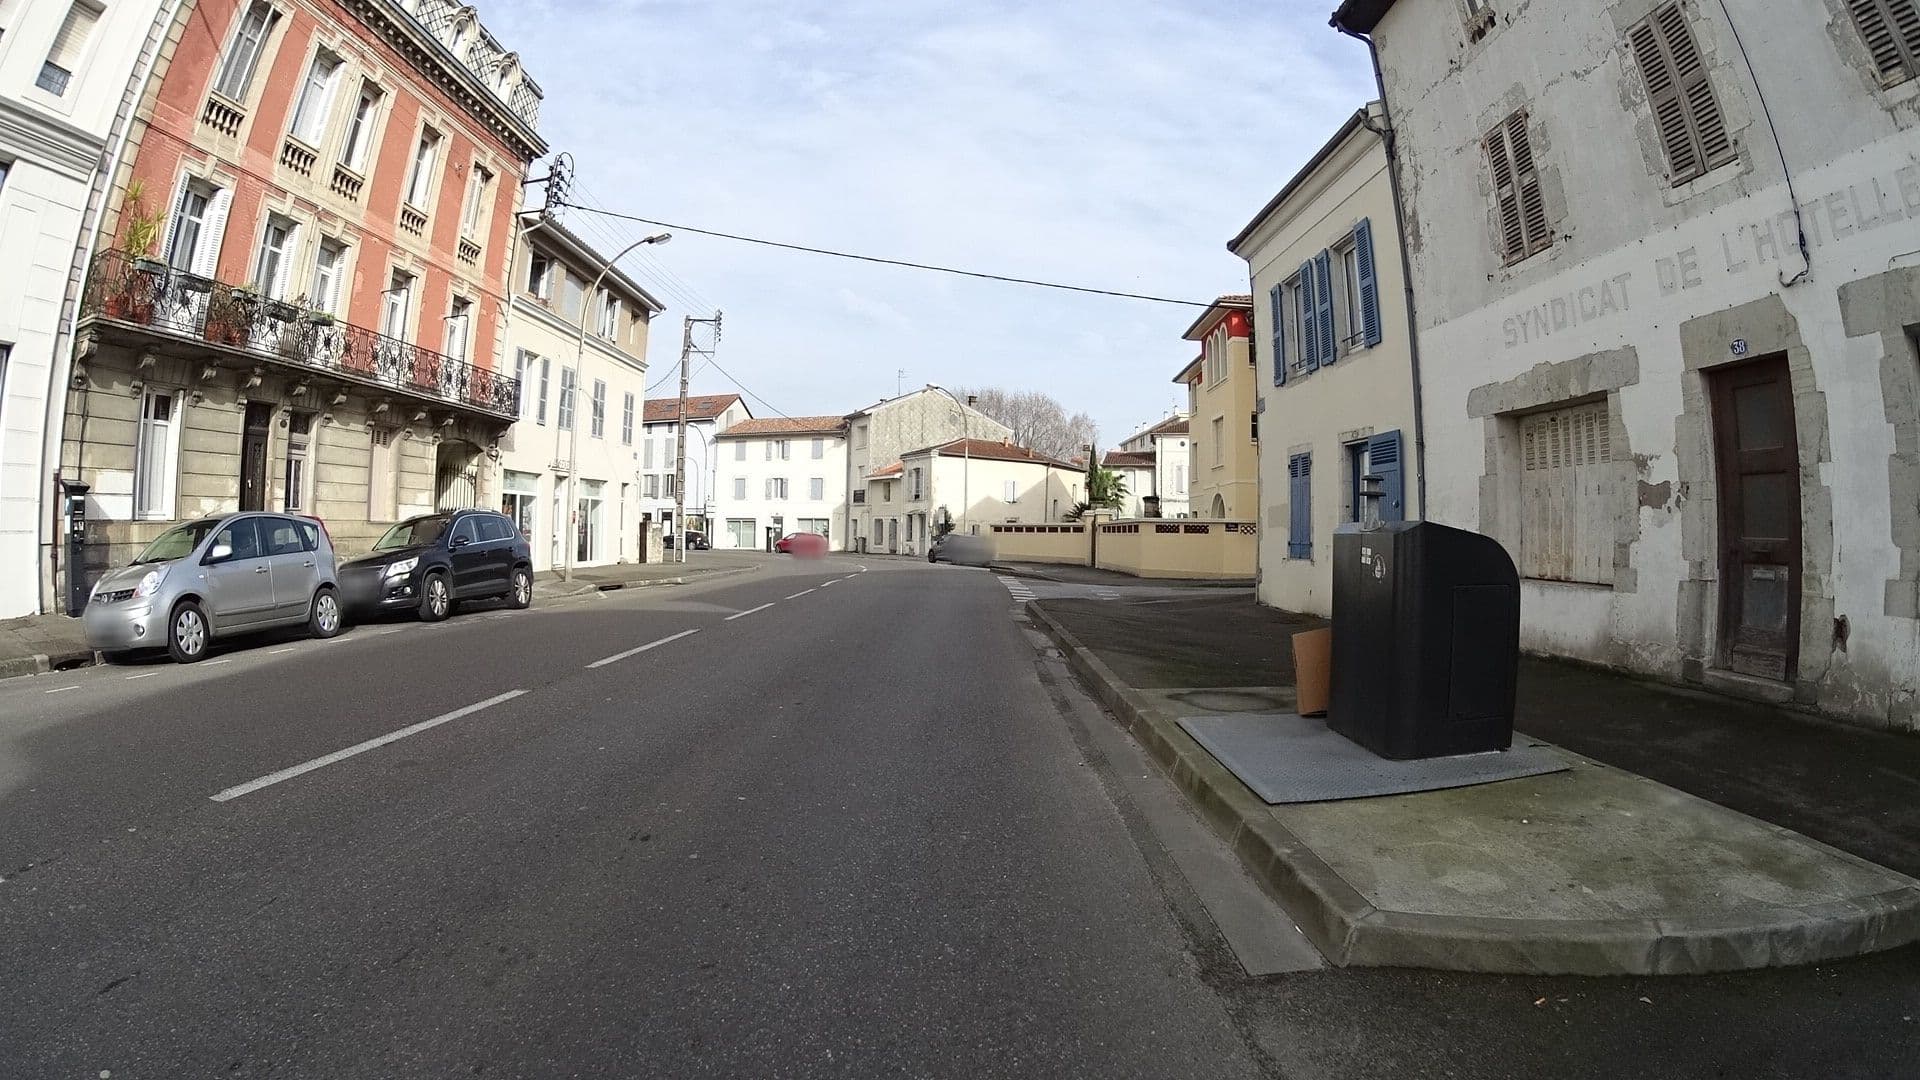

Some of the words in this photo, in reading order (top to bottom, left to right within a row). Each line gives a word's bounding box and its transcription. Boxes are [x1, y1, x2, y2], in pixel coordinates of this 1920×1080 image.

[1502, 272, 1631, 349] SYNDICAT
[1655, 247, 1702, 297] DE
[1733, 340, 1745, 354] 38
